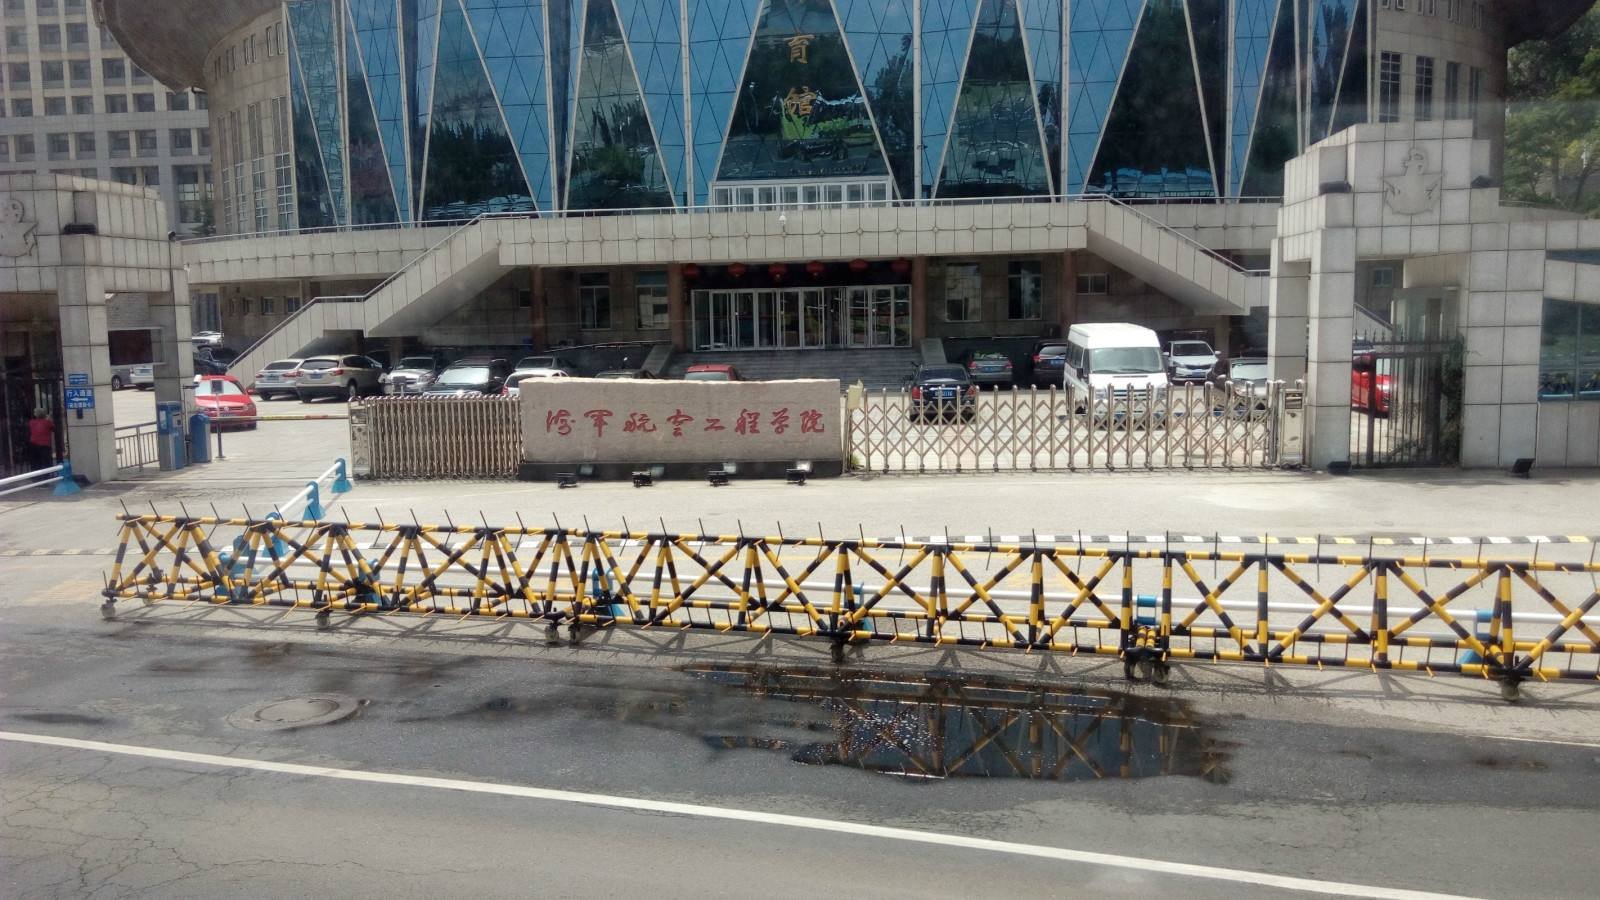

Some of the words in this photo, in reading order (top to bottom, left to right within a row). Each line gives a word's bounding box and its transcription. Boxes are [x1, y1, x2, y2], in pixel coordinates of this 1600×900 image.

[546, 408, 824, 437] 海军航空工程学院
